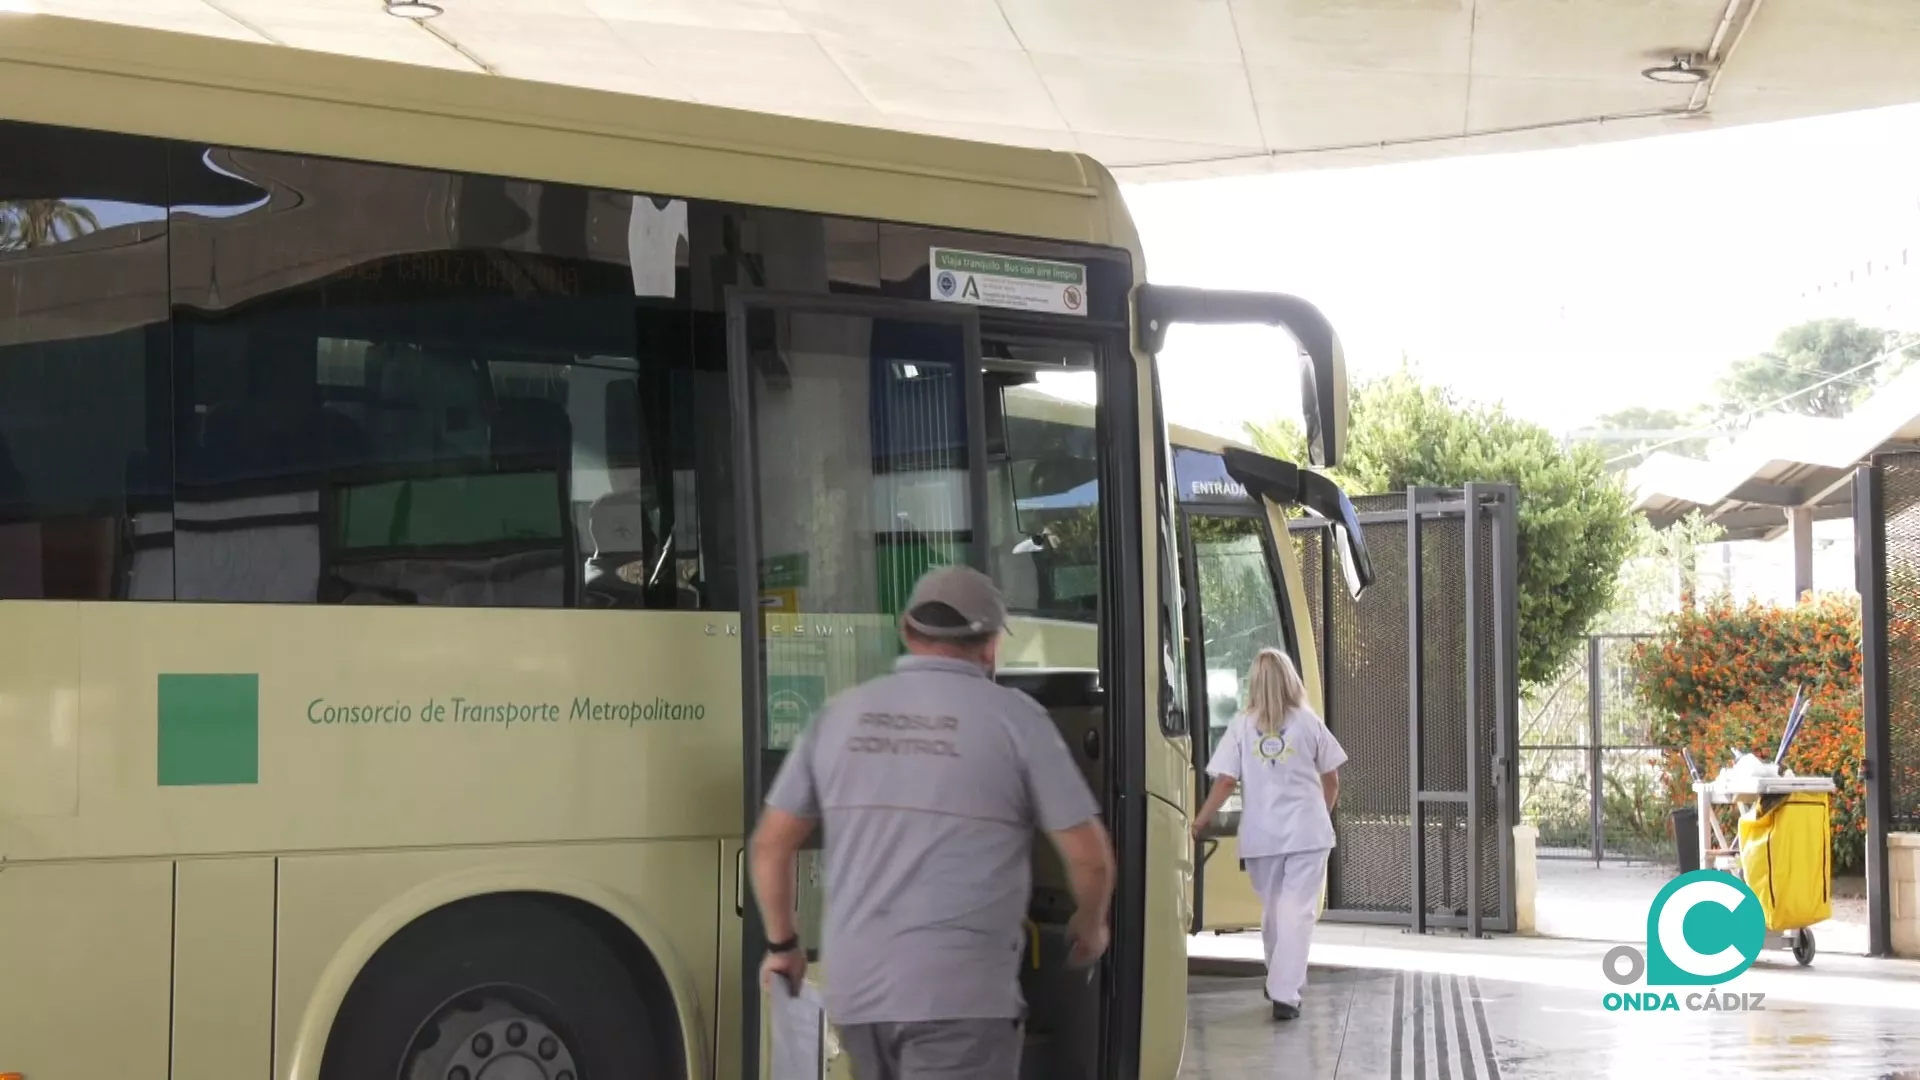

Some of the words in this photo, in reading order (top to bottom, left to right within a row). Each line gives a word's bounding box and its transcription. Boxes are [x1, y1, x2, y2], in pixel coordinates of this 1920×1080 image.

[941, 255, 962, 267] Viaja
[1004, 262, 1019, 273] Bus
[1020, 265, 1035, 275] con
[1036, 266, 1051, 278] aire
[1052, 267, 1078, 281] limpio
[1191, 480, 1248, 496] ENTRADA
[307, 698, 412, 724] Consorcio
[420, 698, 446, 722] de
[451, 697, 560, 729] Transporte
[569, 696, 705, 728] Metropolitano
[859, 711, 958, 731] PROSUR
[847, 736, 961, 758] CONTROL
